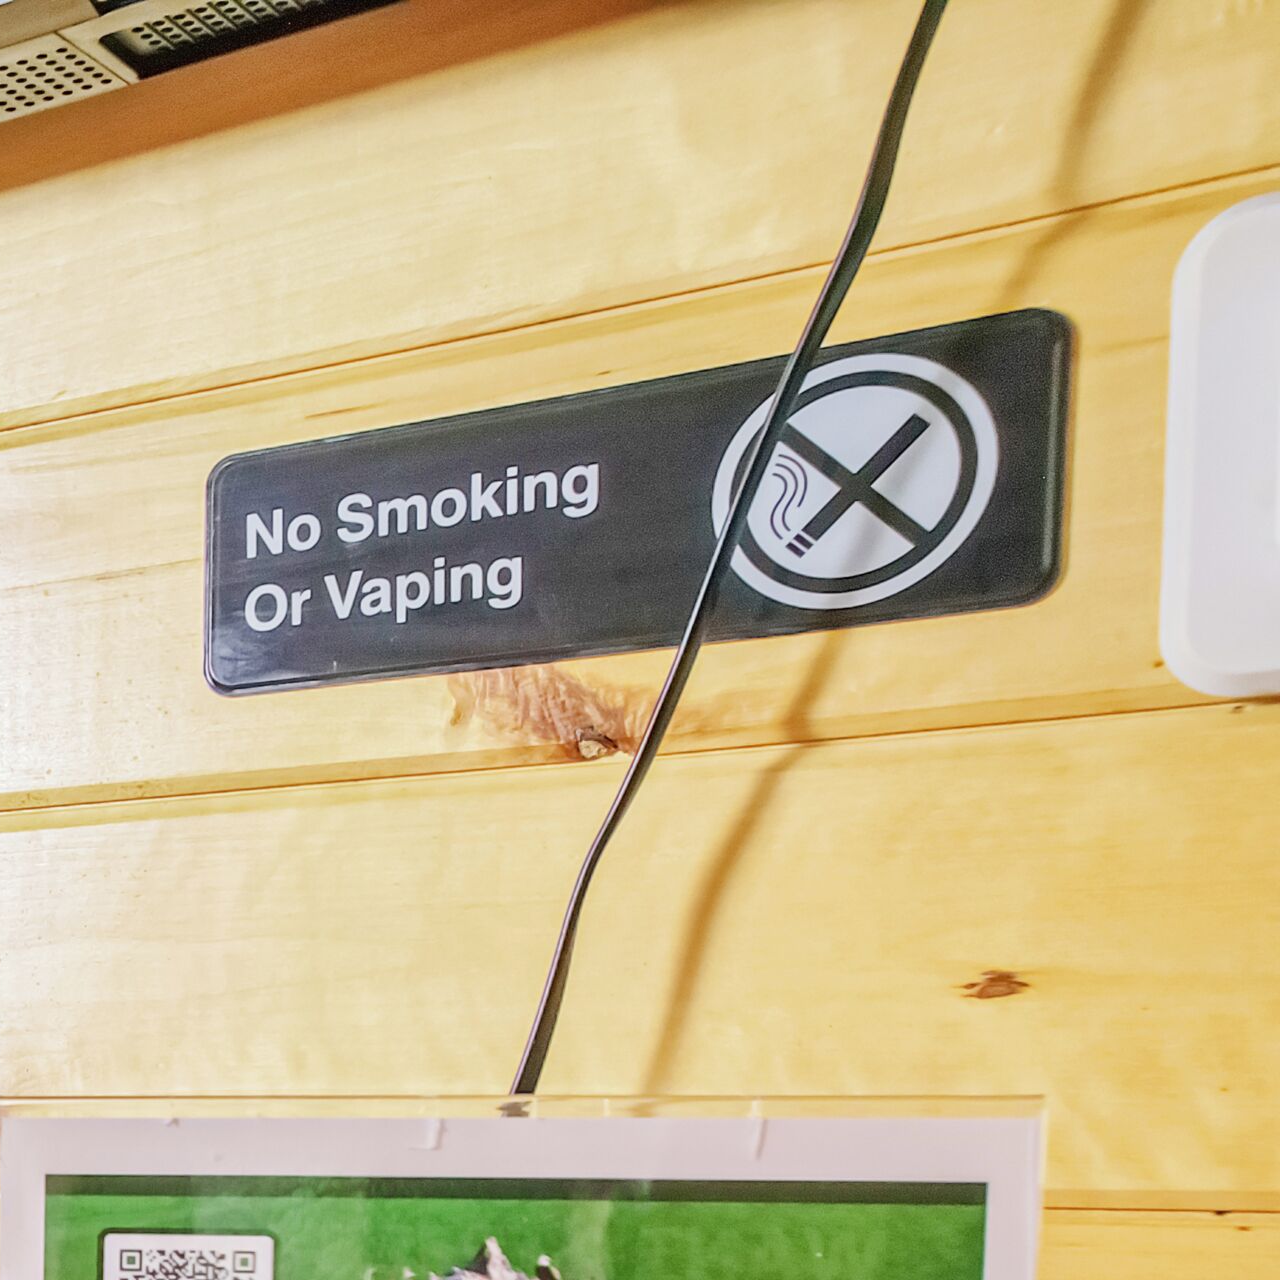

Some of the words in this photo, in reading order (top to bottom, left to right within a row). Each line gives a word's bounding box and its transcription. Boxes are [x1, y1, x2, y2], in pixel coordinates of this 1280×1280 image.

[245, 507, 322, 559] No
[337, 462, 600, 543] Smoking
[244, 582, 312, 632] Or
[323, 555, 523, 624] Vaping
